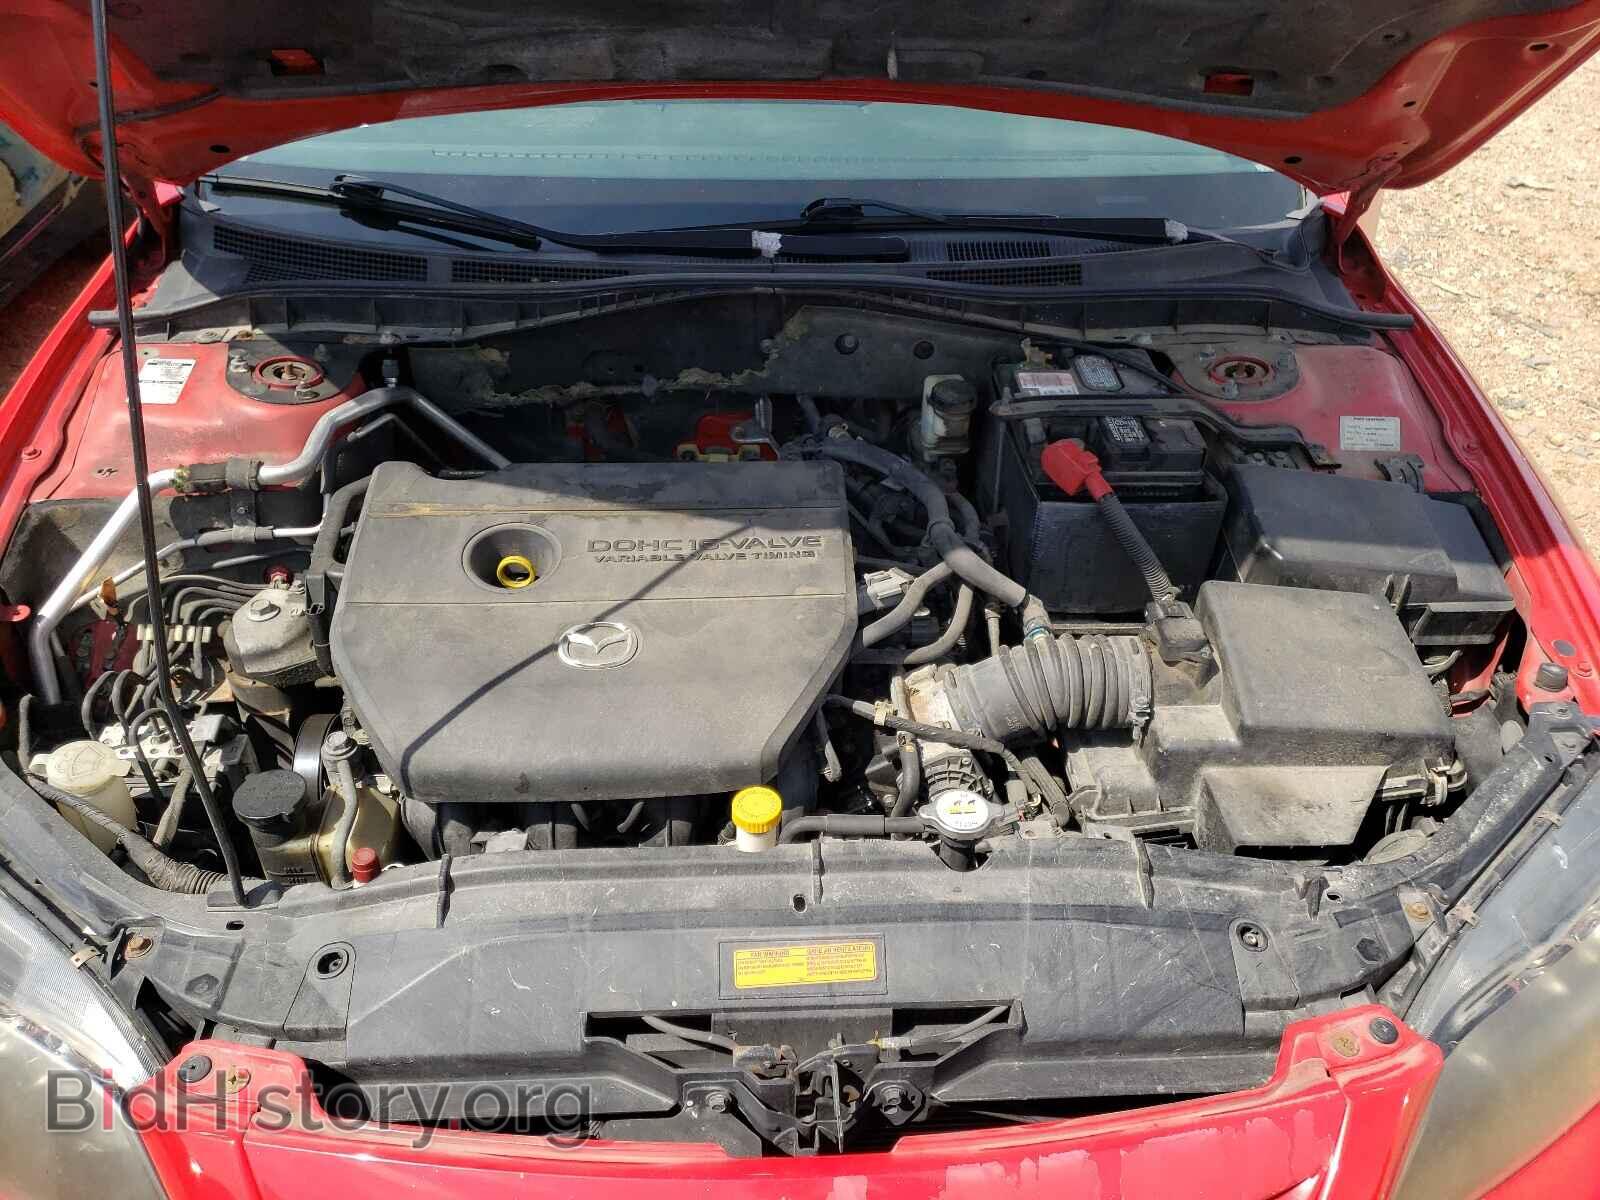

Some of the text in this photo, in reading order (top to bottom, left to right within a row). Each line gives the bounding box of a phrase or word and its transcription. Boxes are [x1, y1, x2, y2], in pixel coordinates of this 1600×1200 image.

[586, 535, 822, 552] DOHC 16-VALVE
[594, 550, 816, 562] VARIABLE VALVE TIMING
